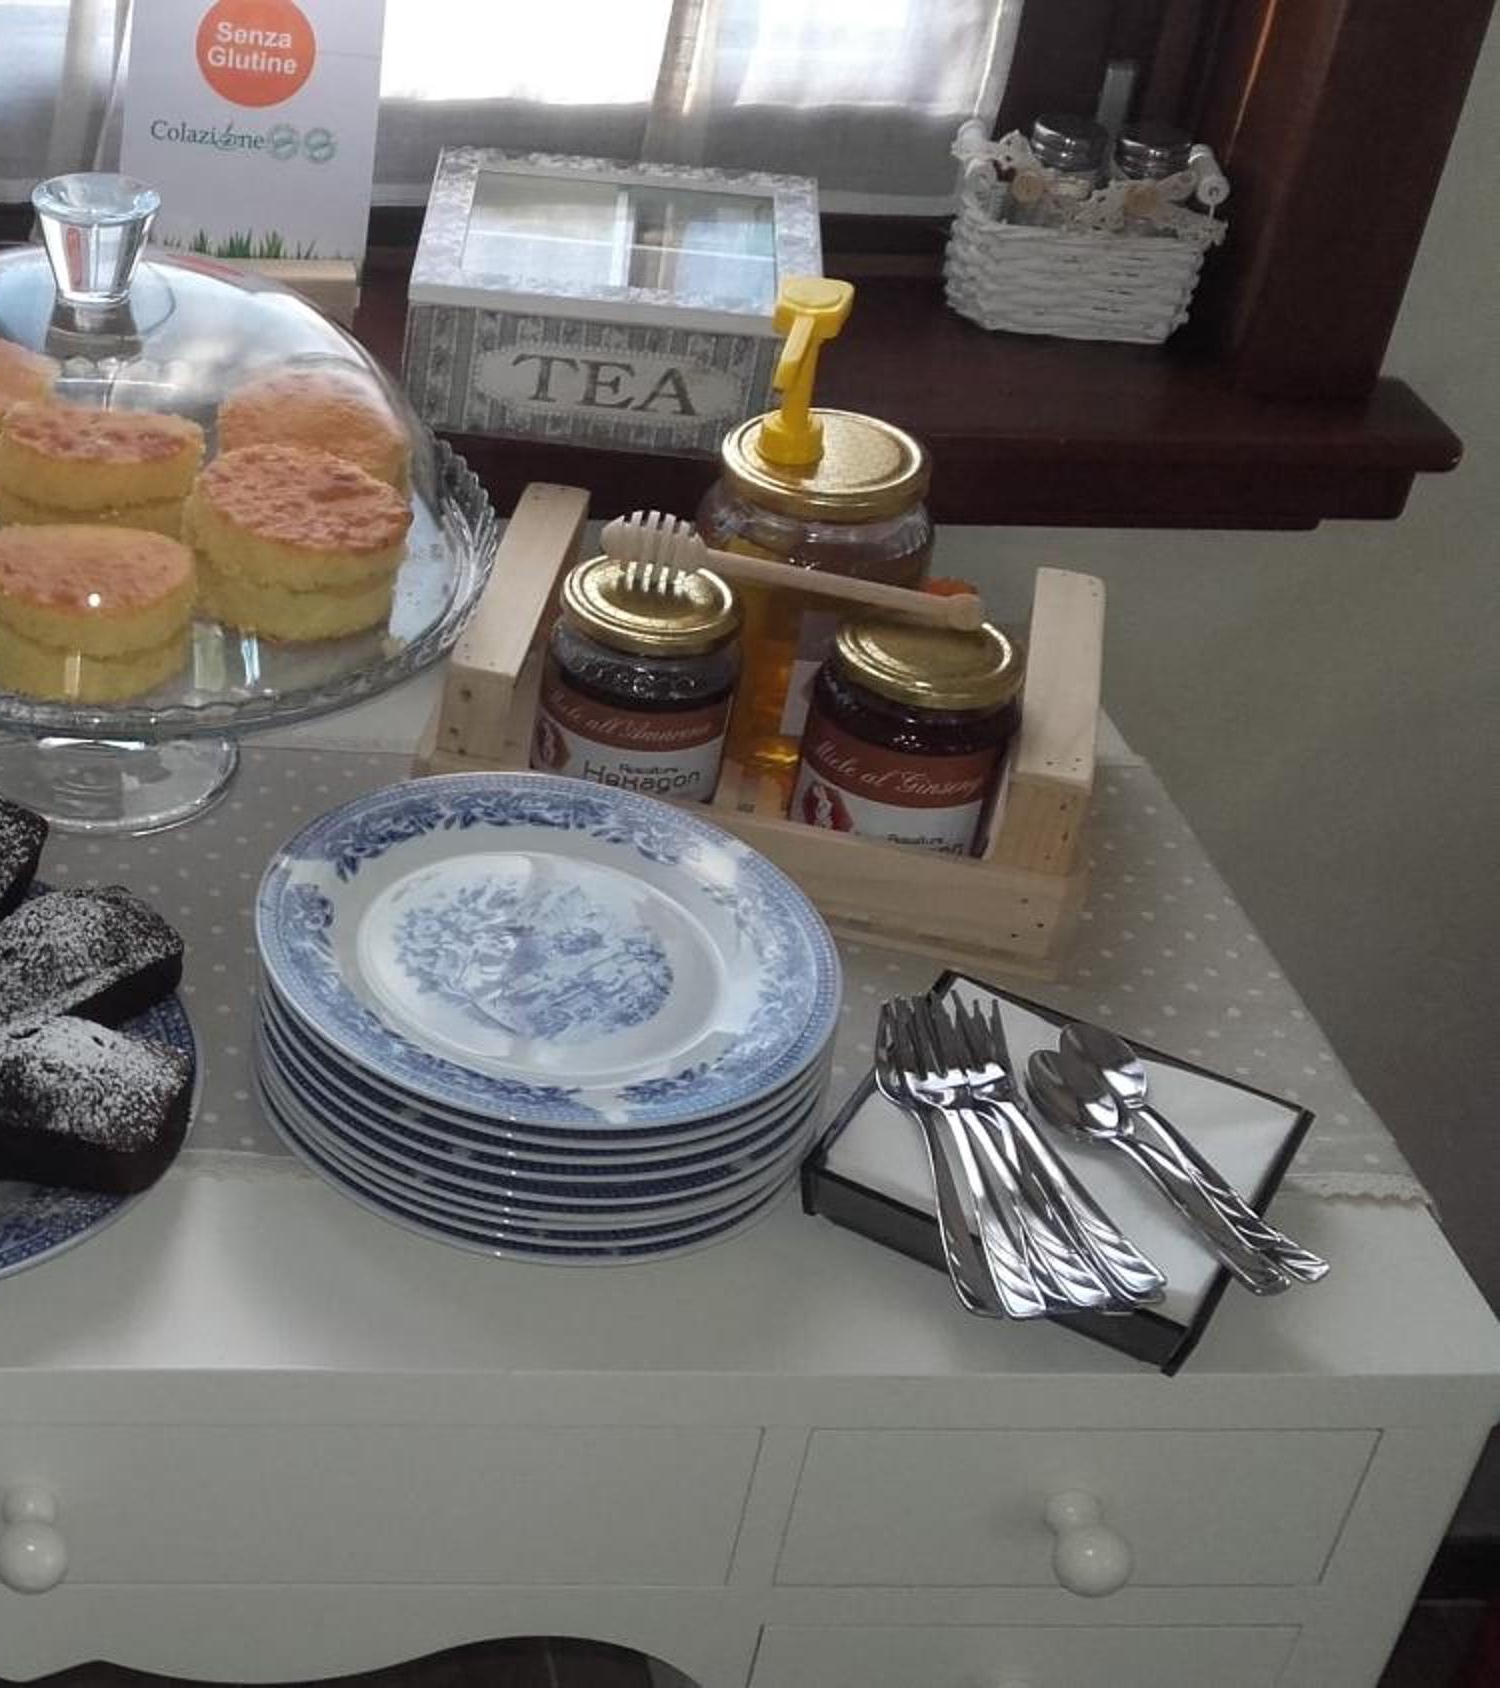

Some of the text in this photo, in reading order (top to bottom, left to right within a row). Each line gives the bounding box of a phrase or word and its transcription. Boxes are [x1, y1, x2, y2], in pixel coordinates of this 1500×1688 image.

[216, 21, 293, 49] Senza
[207, 45, 298, 75] Glutine
[150, 118, 266, 150] Colazione
[512, 353, 698, 416] TEA
